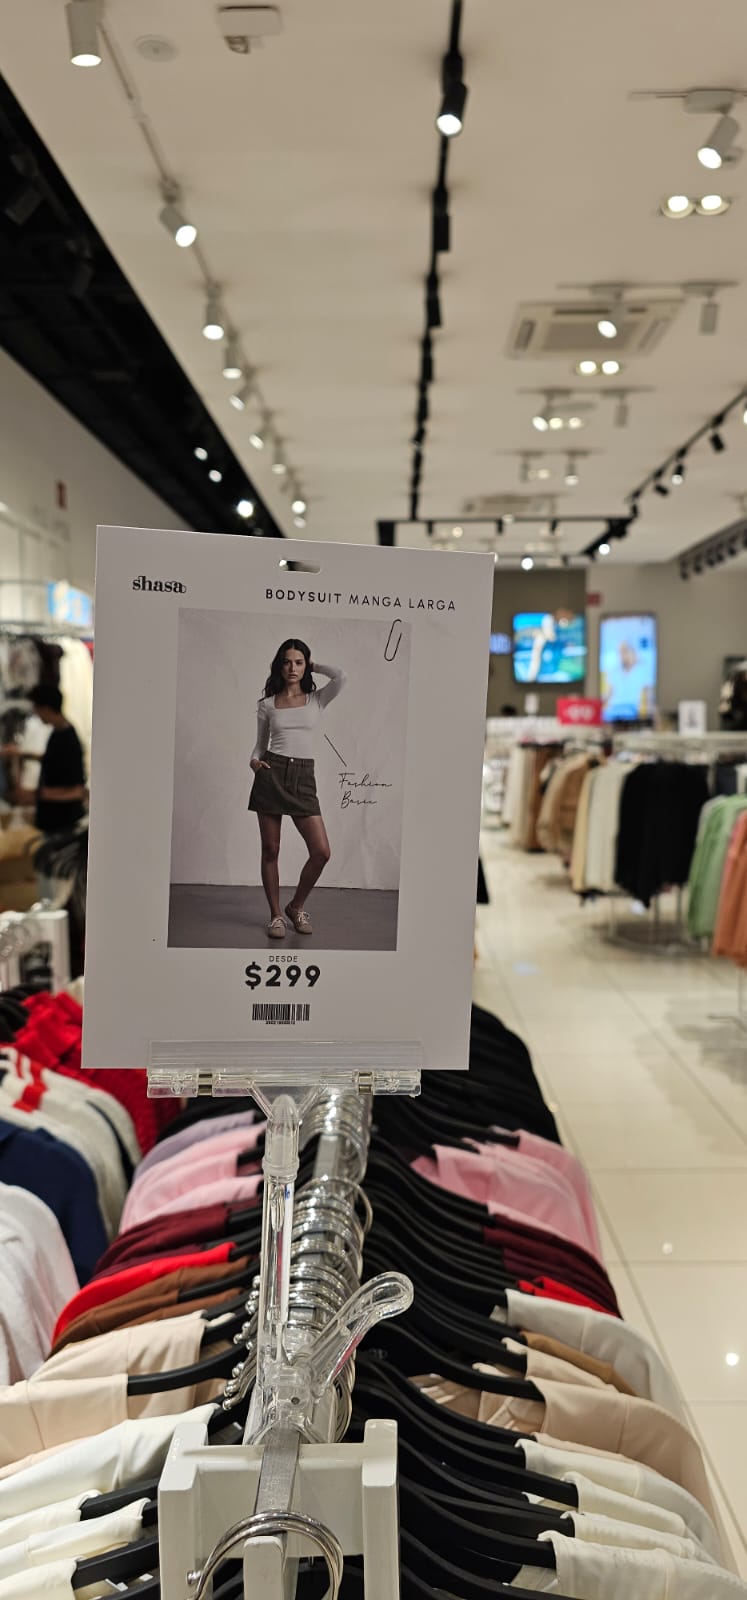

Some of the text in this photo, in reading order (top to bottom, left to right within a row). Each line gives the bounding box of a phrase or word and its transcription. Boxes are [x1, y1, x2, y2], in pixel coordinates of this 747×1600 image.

[132, 575, 187, 594] shasa
[265, 588, 456, 611] BODYSUIT MANGA LARGA
[268, 955, 298, 963] DESDE
[244, 961, 321, 990] $299
